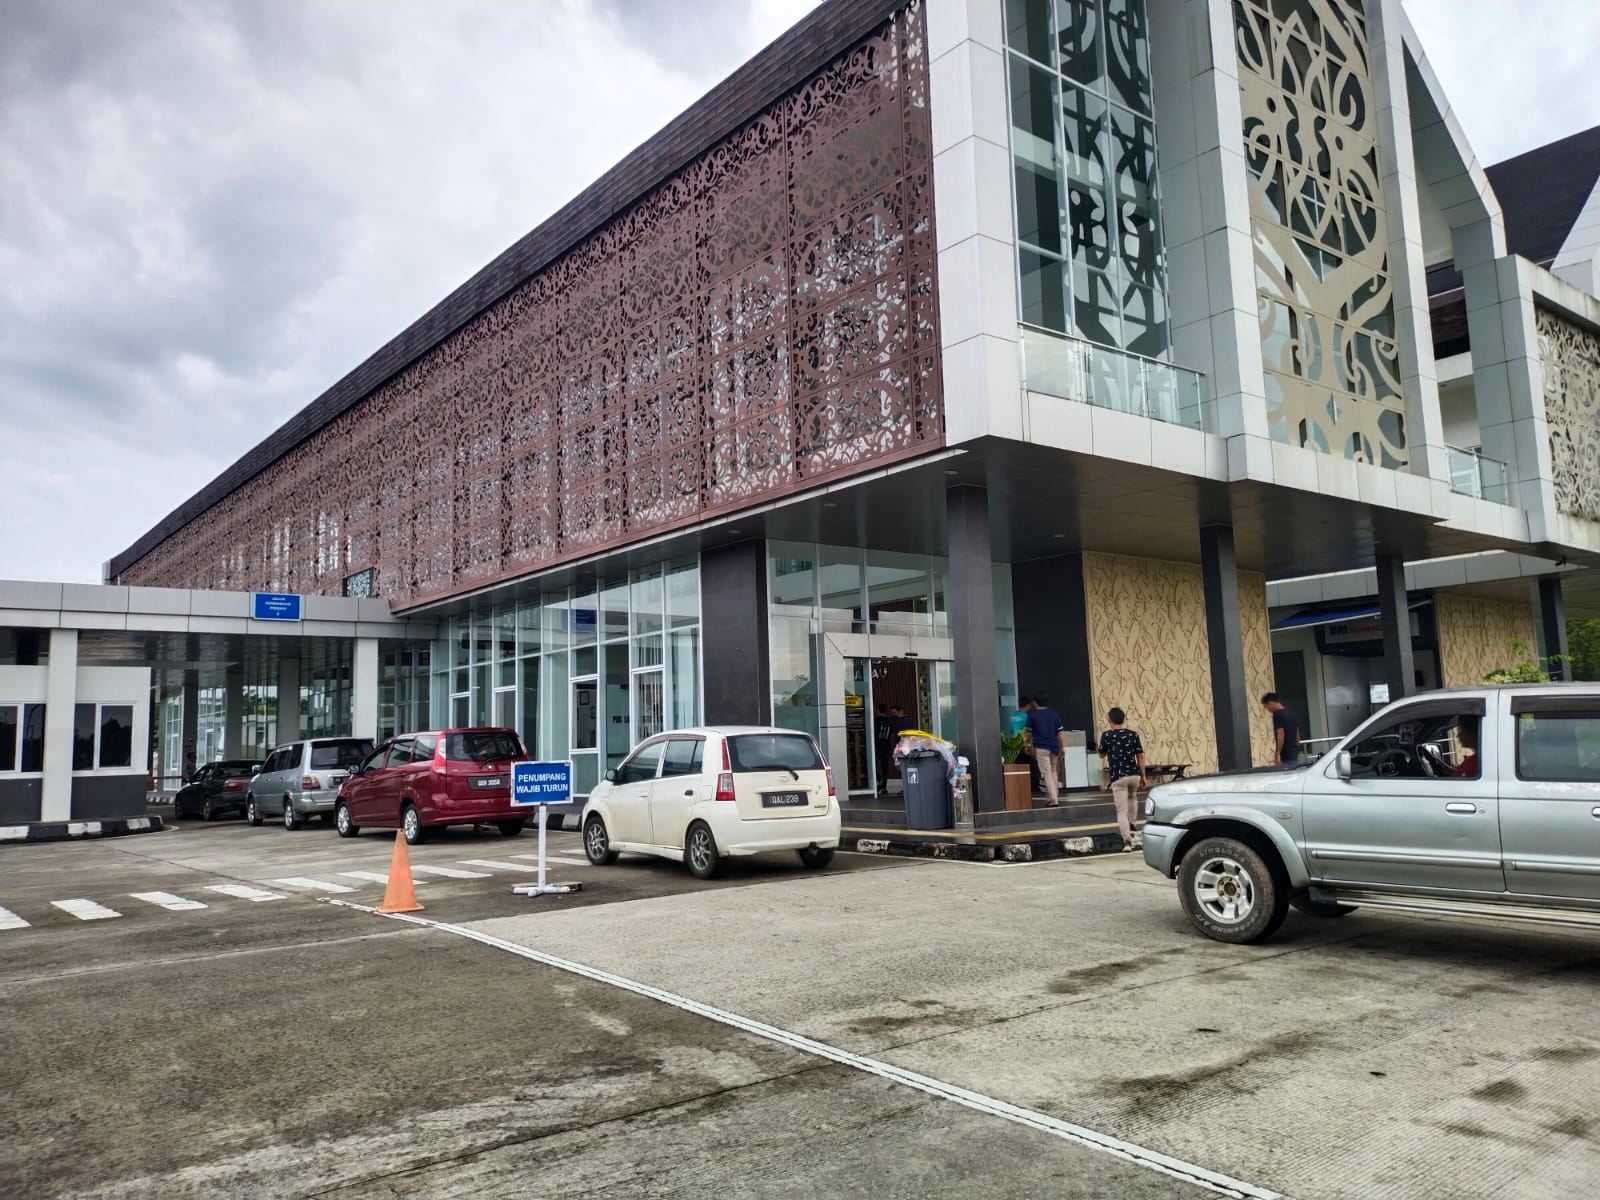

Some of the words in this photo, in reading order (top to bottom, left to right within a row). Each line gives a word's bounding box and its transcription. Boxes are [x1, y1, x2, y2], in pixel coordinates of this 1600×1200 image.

[518, 773, 567, 783] PENUMPANG
[516, 784, 541, 794] WAJIB
[542, 784, 568, 793] TURUN
[785, 794, 799, 803] 239
